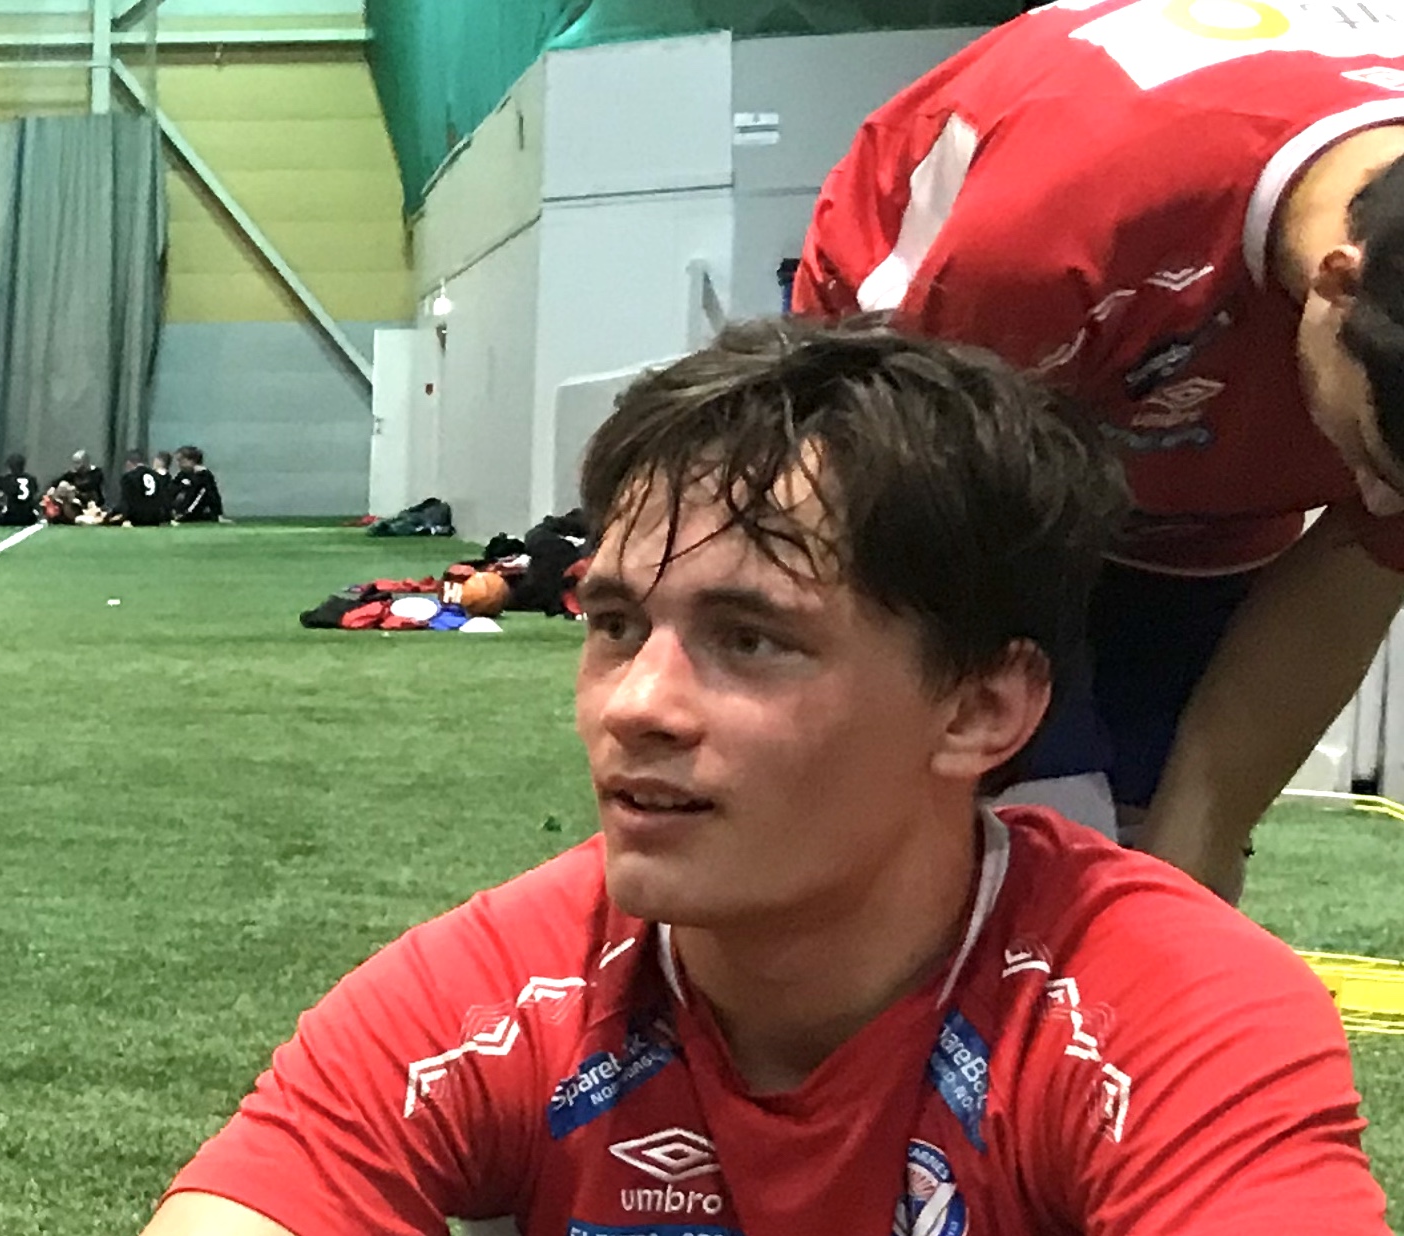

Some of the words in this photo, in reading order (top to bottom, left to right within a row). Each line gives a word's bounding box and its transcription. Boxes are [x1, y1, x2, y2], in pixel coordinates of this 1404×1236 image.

[16, 477, 30, 500] 3
[142, 473, 156, 496] 9
[620, 1183, 724, 1216] umbro
